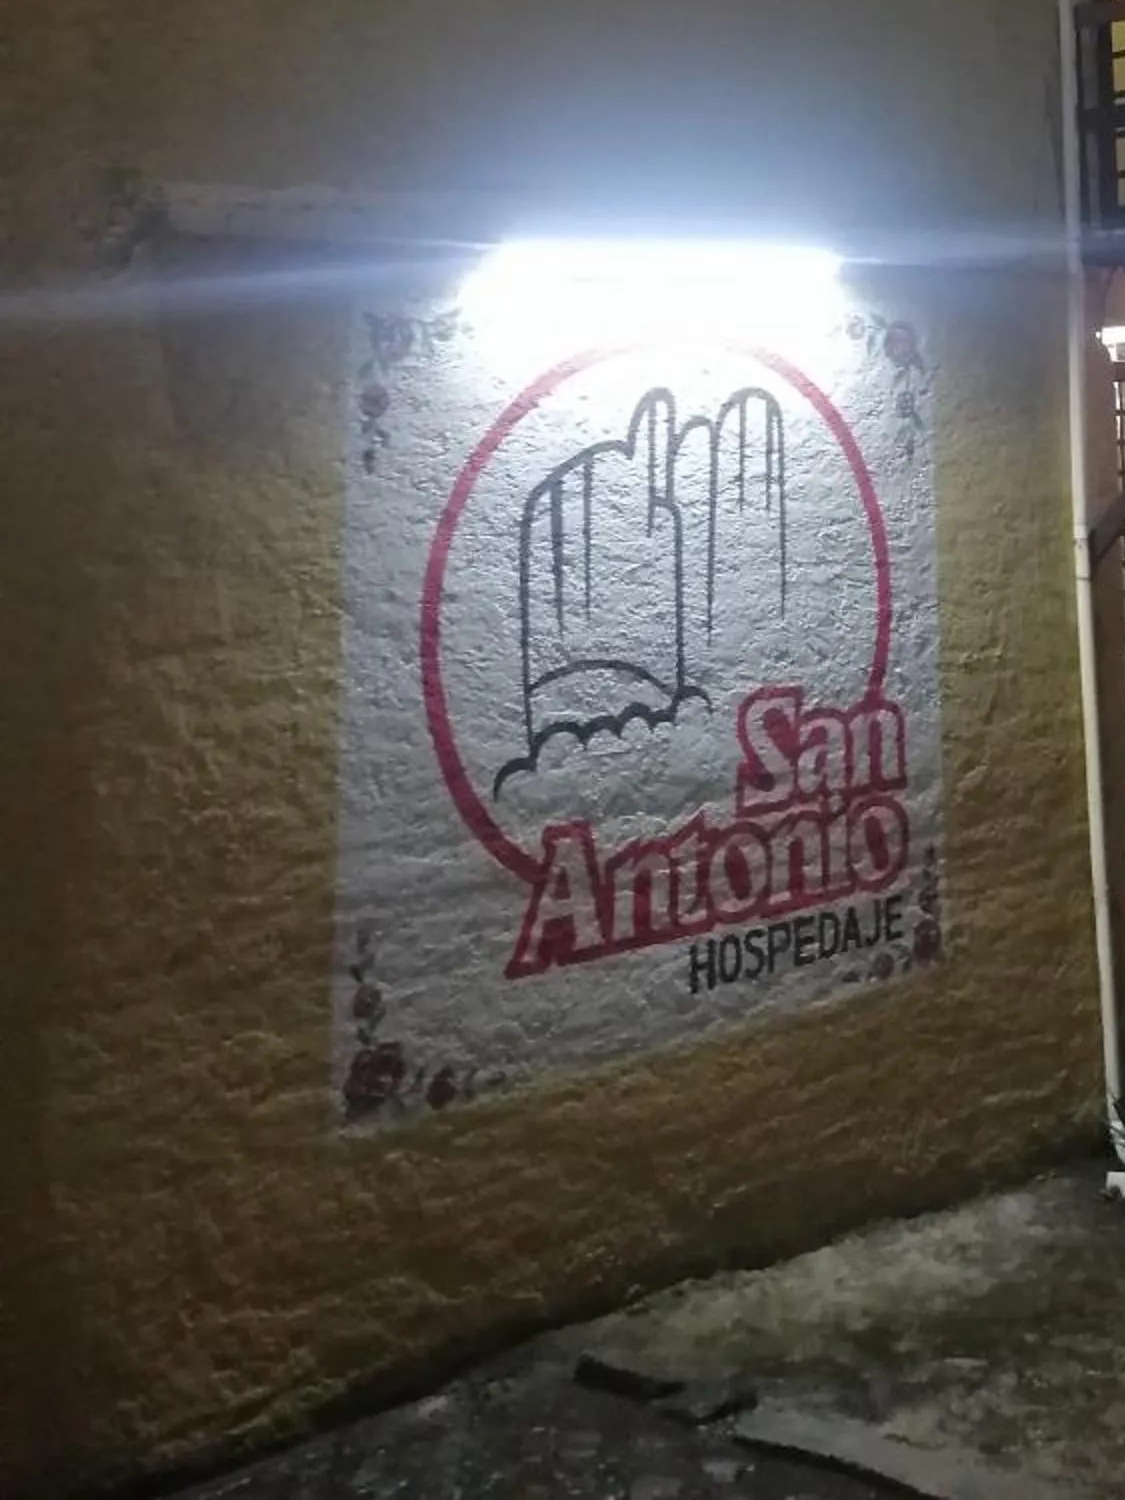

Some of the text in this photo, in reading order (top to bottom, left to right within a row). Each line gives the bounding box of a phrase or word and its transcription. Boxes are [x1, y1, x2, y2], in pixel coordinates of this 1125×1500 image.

[738, 684, 906, 814] San
[506, 798, 908, 977] Antonio
[689, 895, 904, 993] HOSPEDAJE
